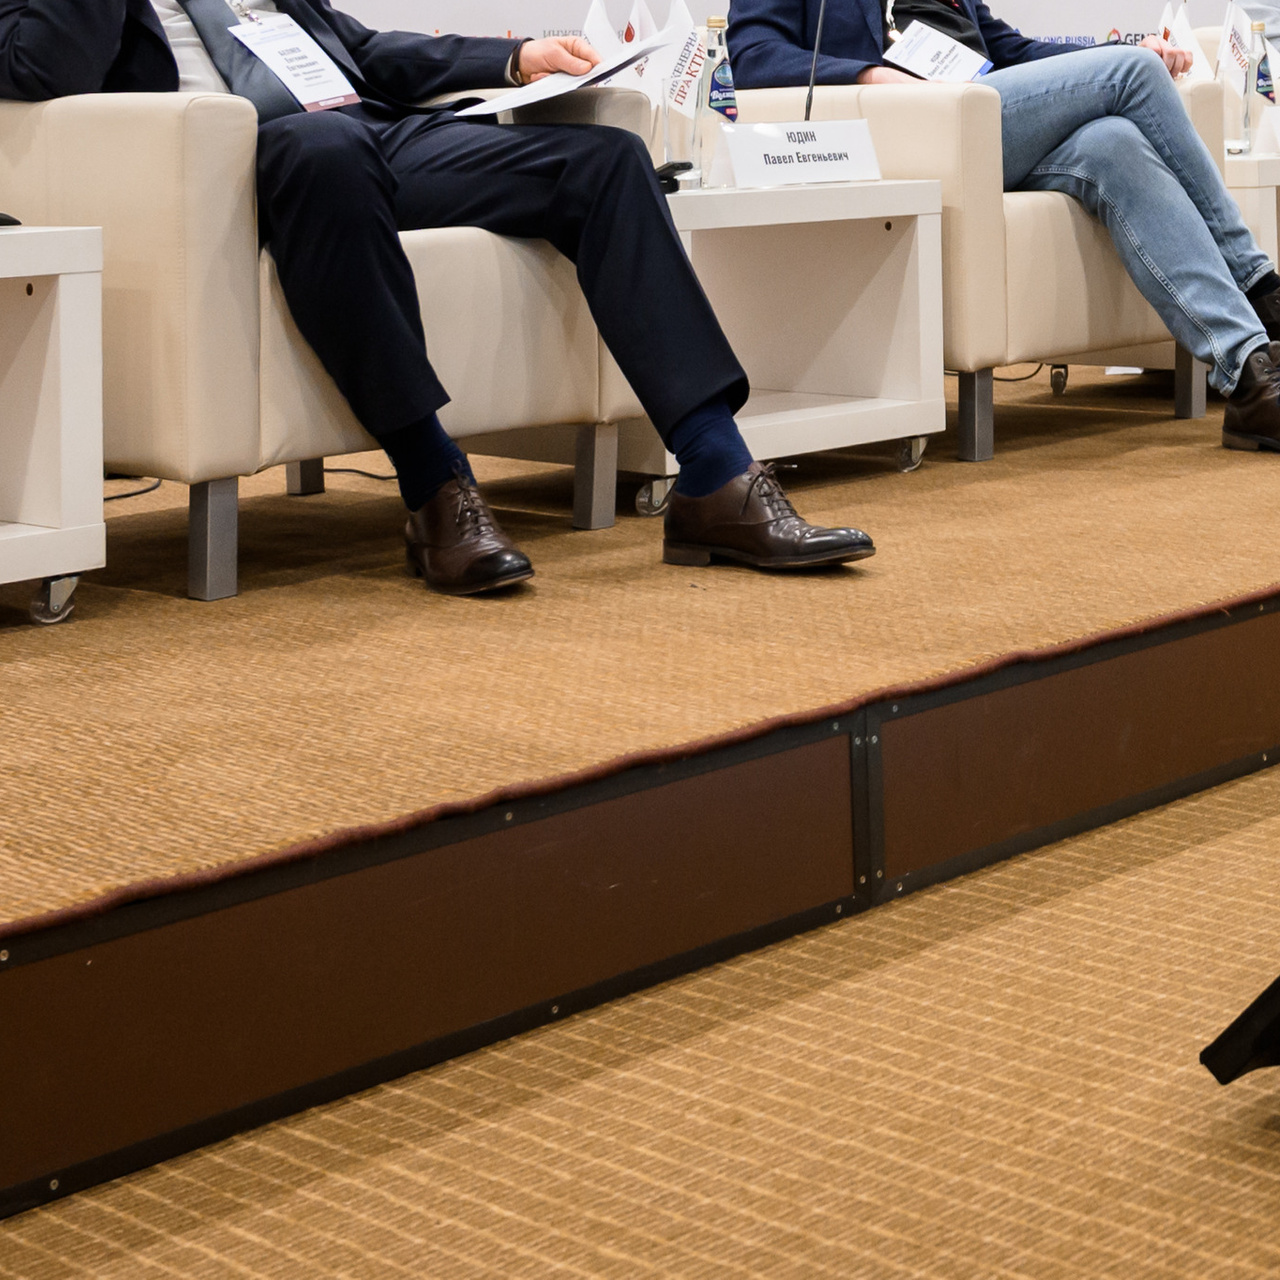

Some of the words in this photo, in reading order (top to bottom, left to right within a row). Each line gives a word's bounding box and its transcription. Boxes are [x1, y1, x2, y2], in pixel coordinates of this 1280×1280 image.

[1065, 36, 1096, 47] RUSSIA
[786, 131, 817, 145] ЮДИН
[763, 153, 794, 166] Павел
[796, 151, 849, 163] Евгеньевич
